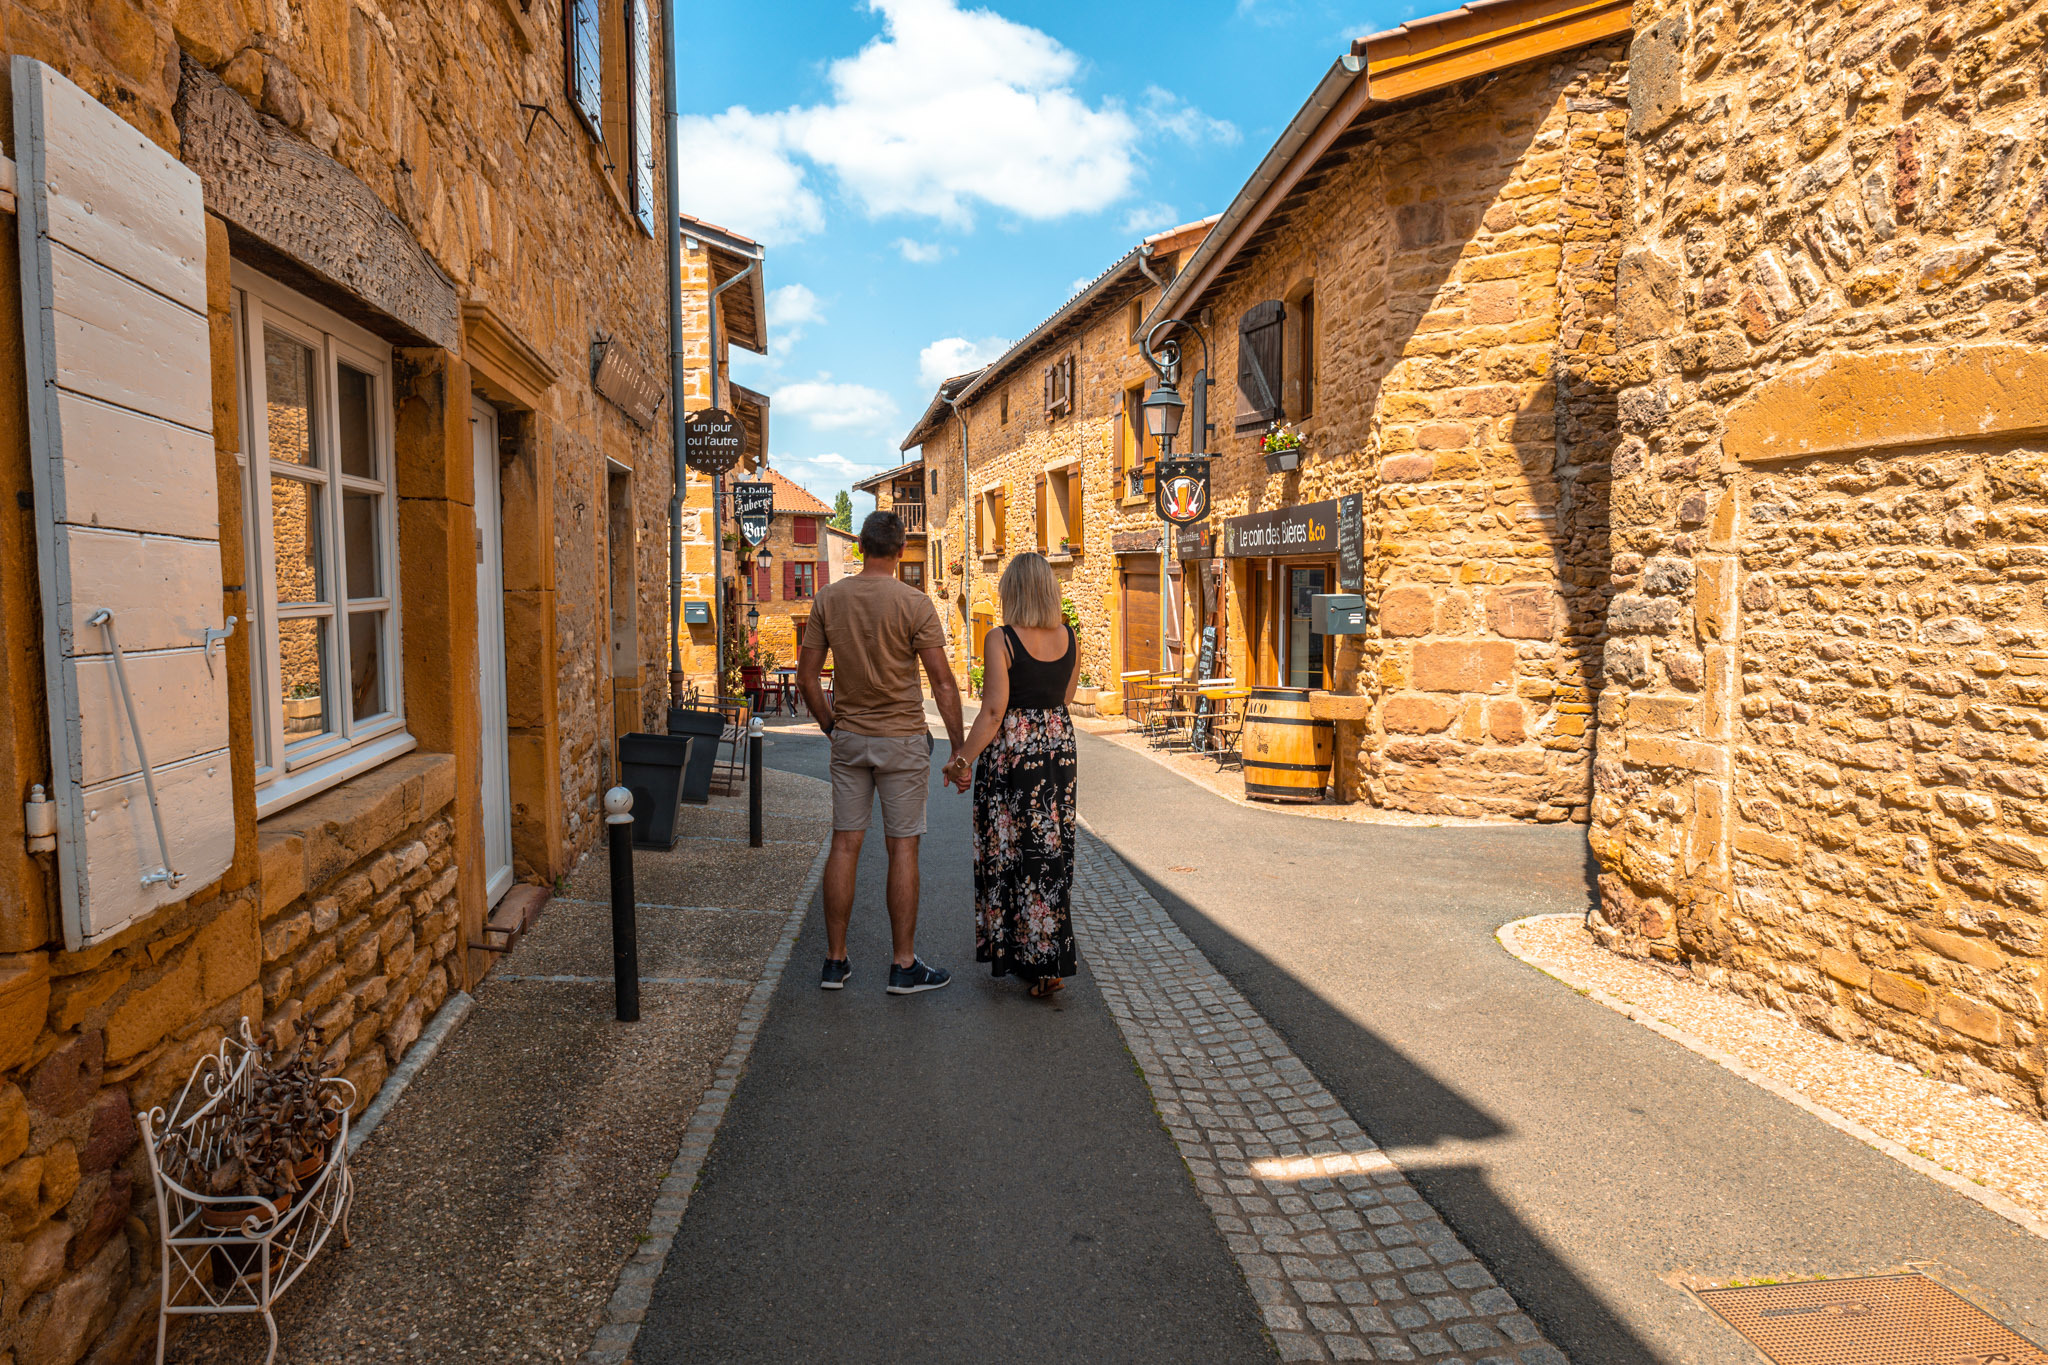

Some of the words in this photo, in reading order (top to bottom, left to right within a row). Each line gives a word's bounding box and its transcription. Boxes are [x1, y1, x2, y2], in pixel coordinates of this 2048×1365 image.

[606, 348, 640, 389] GALERIE
[693, 424, 708, 432] un
[708, 422, 732, 435] jour
[687, 438, 702, 446] ou
[704, 435, 739, 446] l'autre
[743, 522, 767, 538] Bar
[1240, 526, 1248, 547] Le
[1248, 523, 1265, 547] coin
[1265, 522, 1281, 545] des
[1281, 518, 1307, 544] Bières
[1308, 518, 1326, 542] &co
